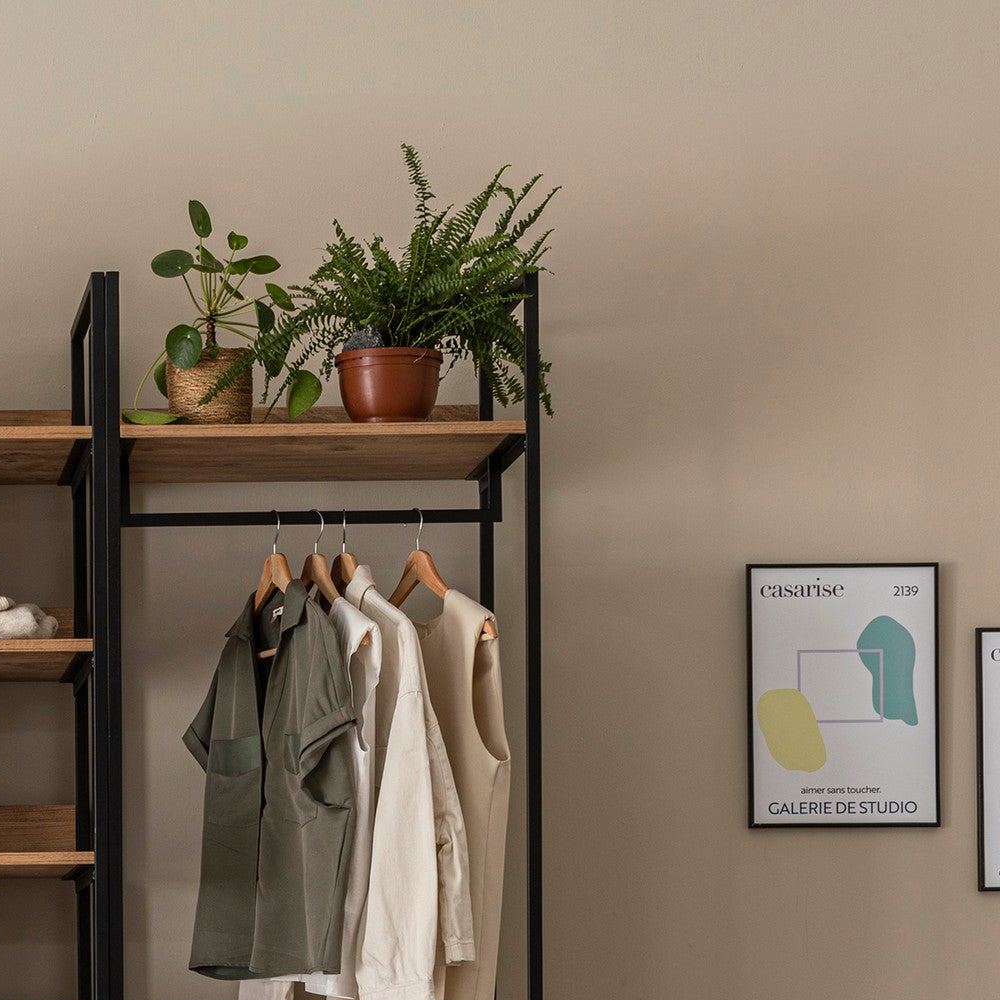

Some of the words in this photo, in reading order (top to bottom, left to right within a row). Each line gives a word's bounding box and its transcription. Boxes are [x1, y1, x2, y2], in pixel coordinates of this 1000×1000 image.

[760, 577, 845, 598] casarise
[893, 585, 919, 597] 2139
[800, 786, 825, 795] aimer
[826, 786, 846, 795] sans
[847, 785, 882, 794] toucher.
[768, 801, 833, 815] GALERIE
[836, 801, 857, 815] DE
[859, 800, 918, 814] STUDIO
